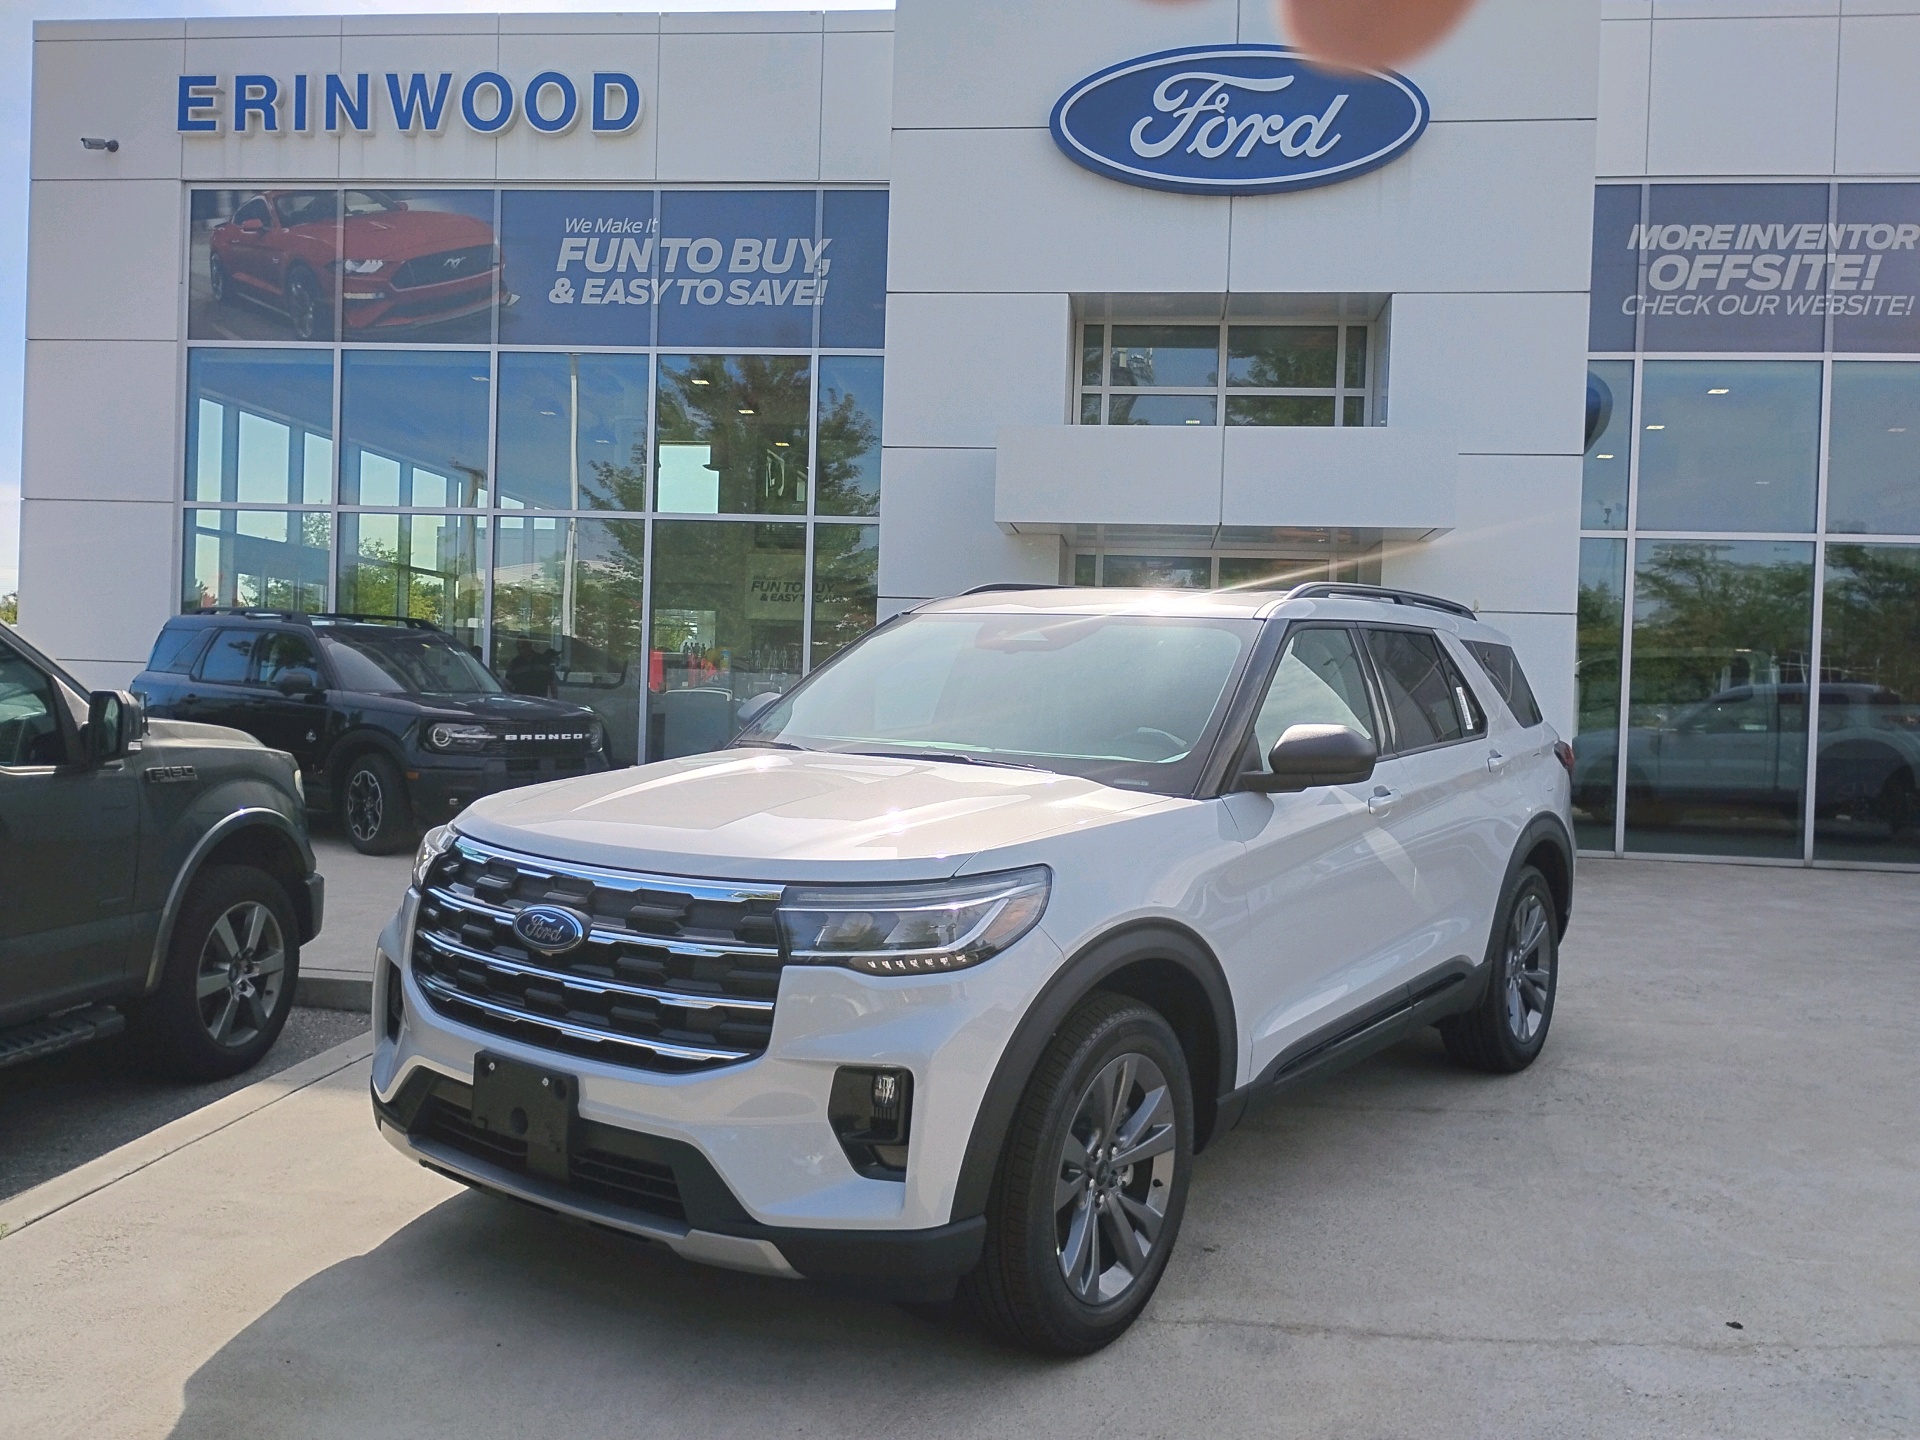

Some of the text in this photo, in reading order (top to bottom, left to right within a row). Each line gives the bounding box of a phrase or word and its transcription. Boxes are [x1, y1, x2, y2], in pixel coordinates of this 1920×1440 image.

[177, 70, 643, 135] ERINWOOD
[1130, 72, 1349, 159] Ford
[565, 217, 659, 234] We Make It
[1626, 223, 1920, 251] MORE INVENTOR
[556, 237, 833, 277] FUN TO BUY,
[1648, 253, 1883, 292] OFFSITE!
[548, 277, 829, 306] & EASY TO SAVE!
[1621, 294, 1916, 316] CHECK OUR WEBSITE!
[750, 580, 782, 593] FUN
[783, 582, 803, 593] TO
[770, 593, 800, 602] EASY
[505, 733, 584, 741] BRONCO
[525, 914, 565, 942] Ford
